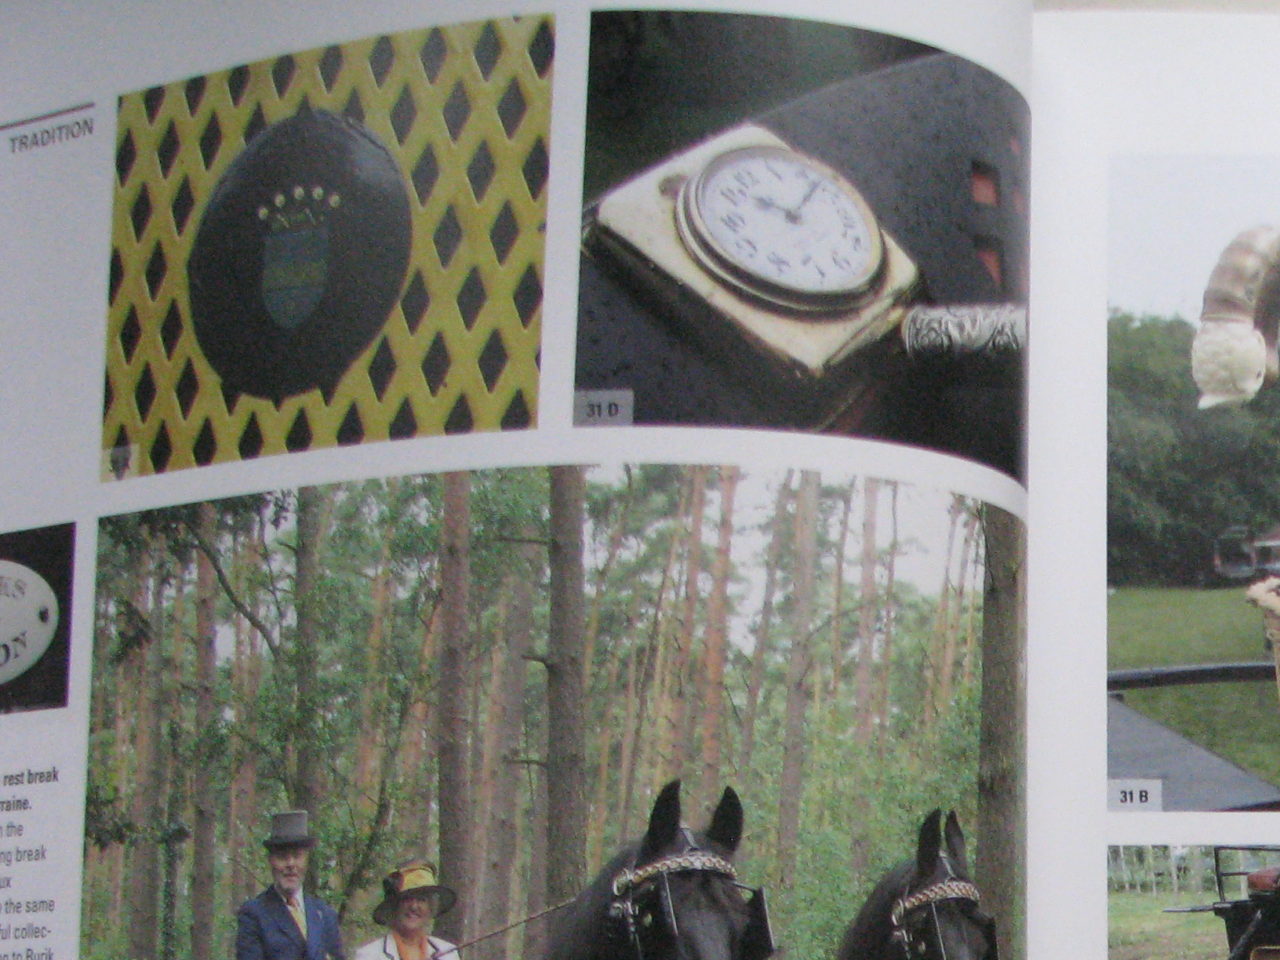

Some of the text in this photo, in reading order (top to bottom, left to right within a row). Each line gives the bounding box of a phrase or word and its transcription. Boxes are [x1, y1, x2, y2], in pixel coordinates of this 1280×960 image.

[10, 118, 94, 152] TRADITION
[587, 404, 619, 417] 31 D
[4, 767, 59, 786] rest break
[1120, 790, 1148, 803] 31 B
[6, 821, 24, 837] the
[15, 844, 47, 861] break
[5, 899, 55, 914] the same
[14, 923, 51, 940] collec-
